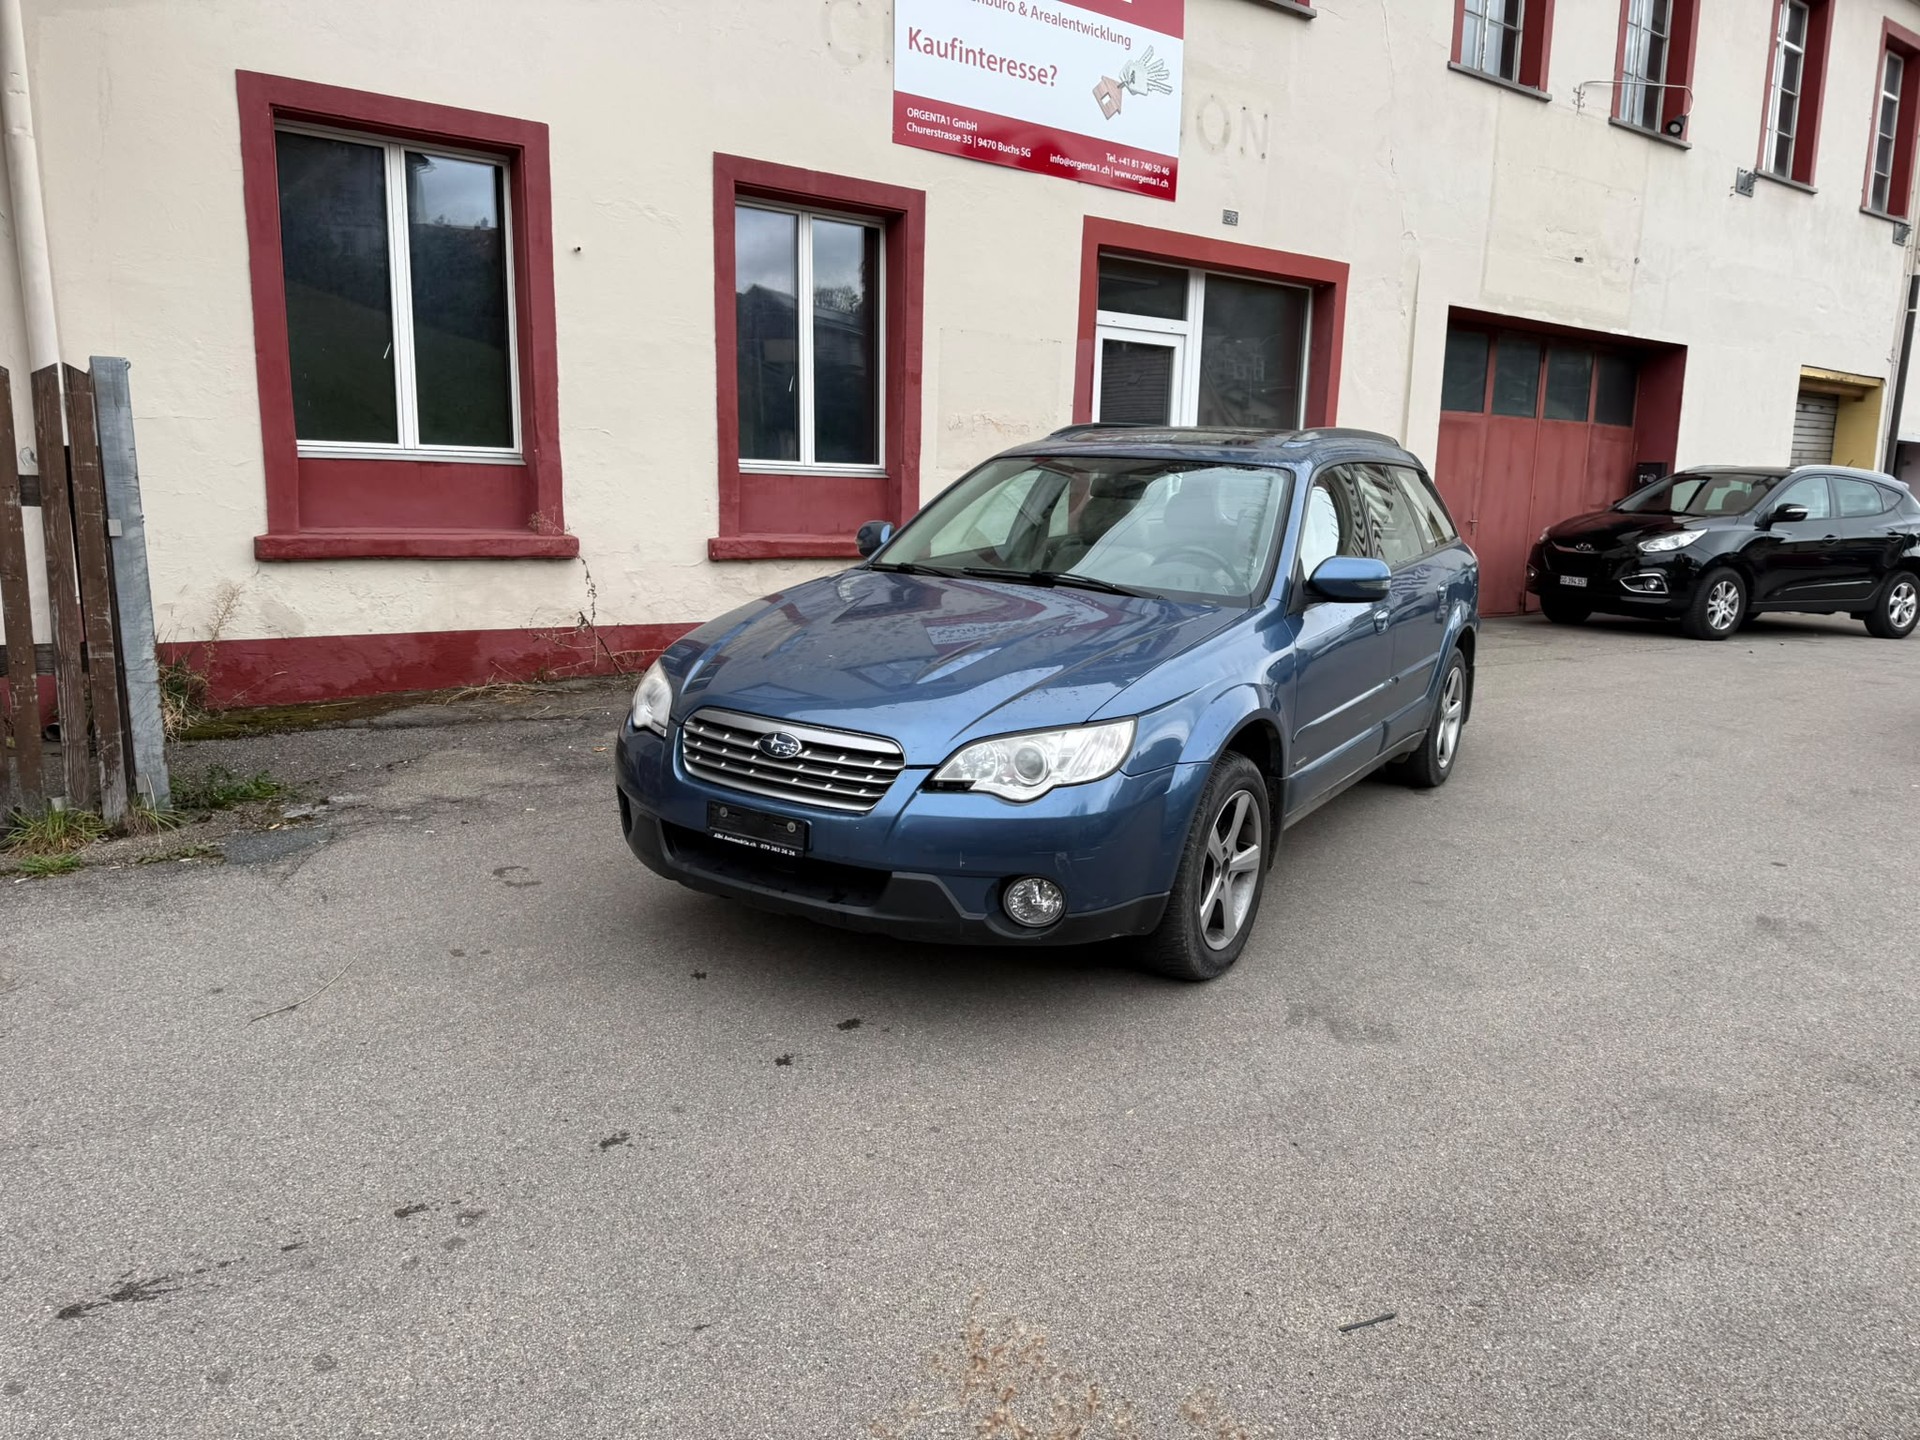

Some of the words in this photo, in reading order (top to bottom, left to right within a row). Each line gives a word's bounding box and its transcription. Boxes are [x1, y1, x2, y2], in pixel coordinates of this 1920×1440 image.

[1018, 1, 1028, 16] &
[1031, 5, 1132, 50] Arealentwicklung
[908, 26, 1058, 87] Kaufinteresse?
[906, 107, 951, 125] ORGENTA1
[952, 117, 978, 131] GmbH
[906, 122, 961, 142] Churerstrasse
[962, 134, 972, 145] 35
[978, 137, 997, 150] 9470
[998, 142, 1020, 155] Buchs
[1021, 147, 1032, 157] SG
[1050, 154, 1110, 175] info@orgenta1.ch
[1114, 168, 1169, 188] www.orgenta1.ch
[1106, 153, 1118, 164] Tel.
[1118, 156, 1131, 166] +41
[1132, 159, 1139, 168] 81
[1140, 161, 1152, 172] 740
[1153, 164, 1161, 174] 50
[1161, 166, 1170, 176] 46
